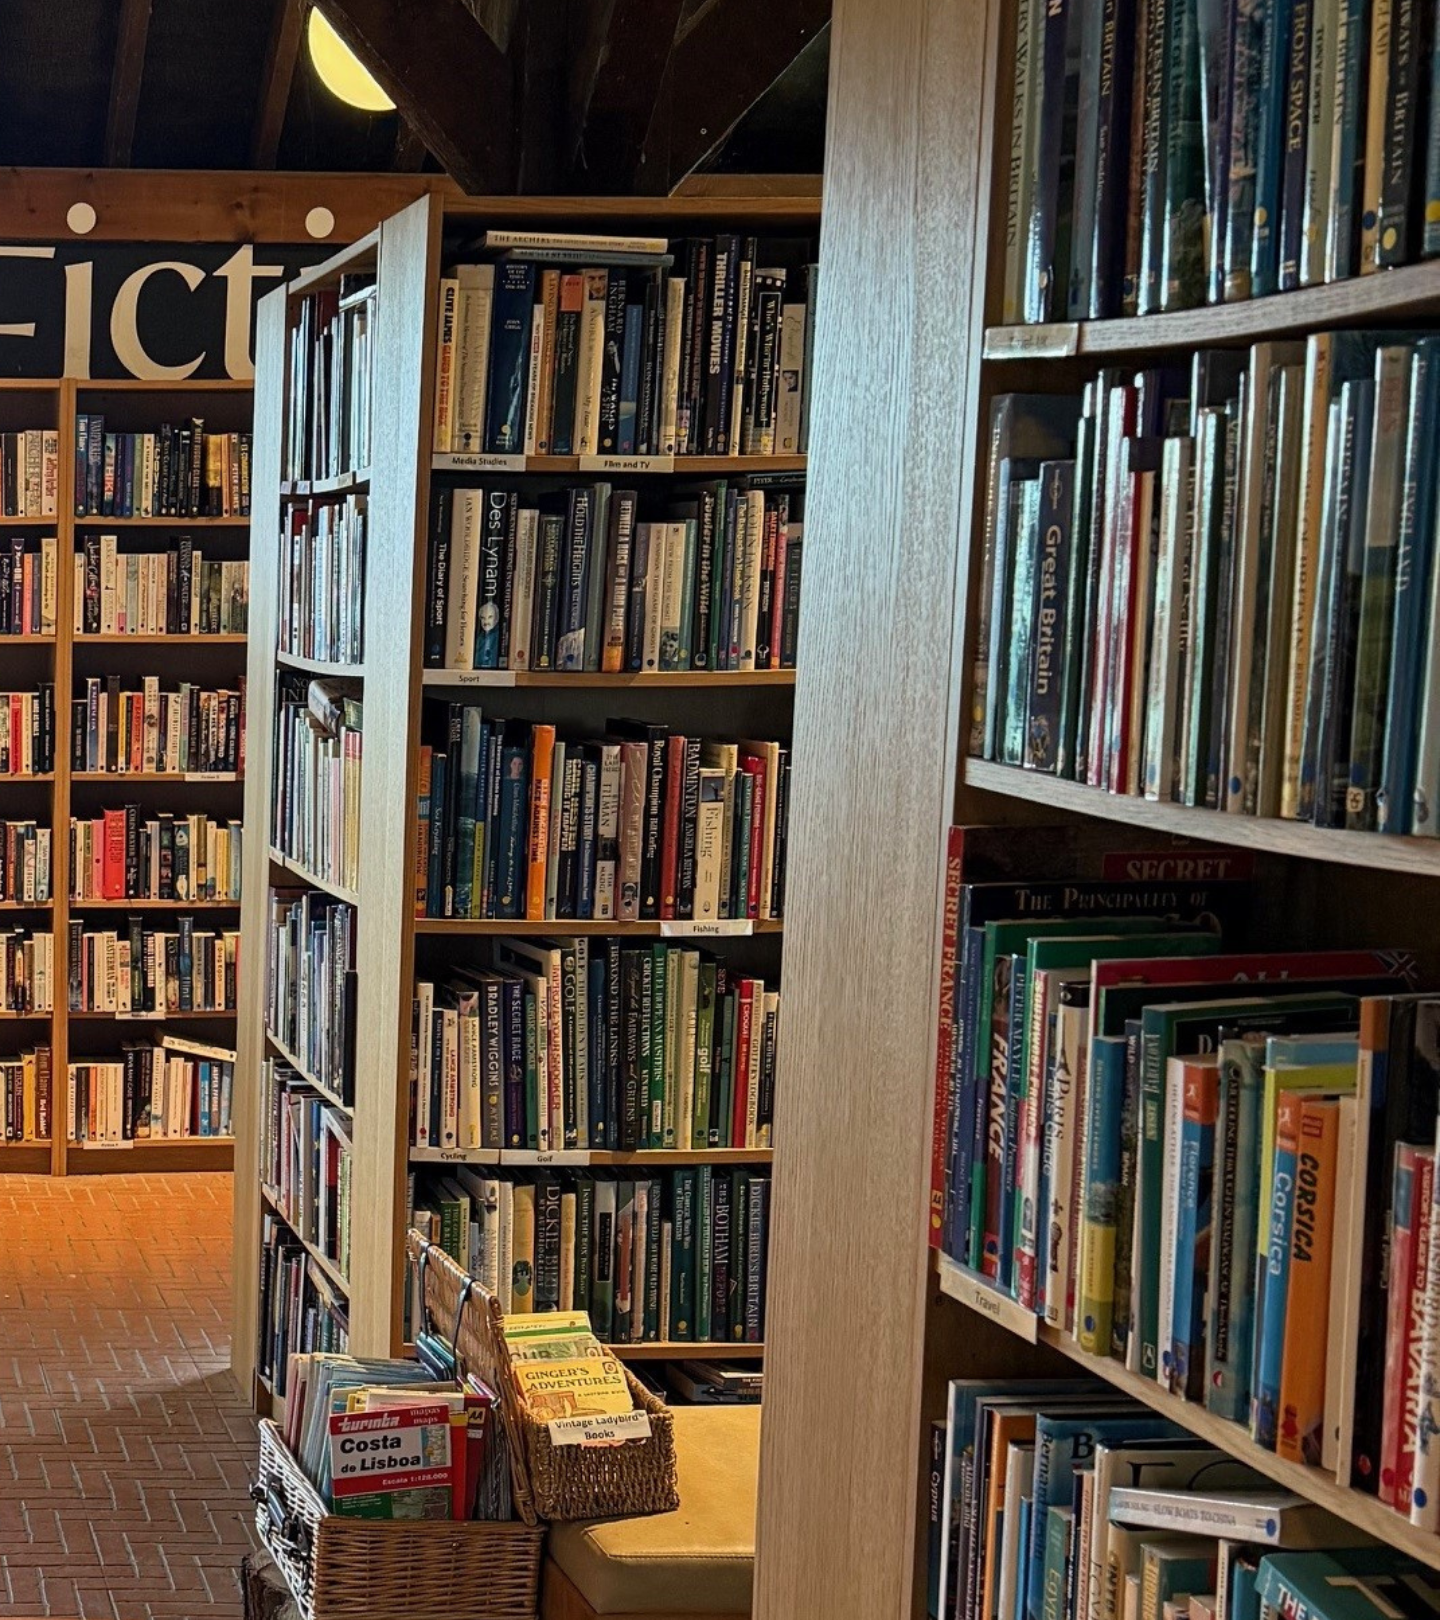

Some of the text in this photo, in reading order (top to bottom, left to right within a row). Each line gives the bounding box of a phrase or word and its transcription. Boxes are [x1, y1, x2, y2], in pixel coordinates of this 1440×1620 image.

[1101, 20, 1114, 95] BRITAIN
[1288, 2, 1307, 153] FROM SPACE
[1007, 40, 1028, 247] WALKS IN BRITAIN
[1390, 91, 1409, 185] BRITAIN
[443, 287, 455, 313] CLIVE
[608, 282, 617, 332] INGHAM
[615, 280, 625, 334] BERNARD
[709, 252, 728, 374] THRILLER MOVIES
[765, 301, 776, 330] Who's
[442, 314, 453, 343] JAMES
[763, 333, 774, 357] Who
[104, 466, 114, 500] HIKE
[452, 457, 507, 467] Media Studies
[575, 497, 588, 527] HOLD
[619, 500, 632, 534] BETWEEN
[482, 492, 506, 597] Des Lynam
[574, 528, 582, 545] THE
[617, 544, 629, 564] ROCK
[699, 496, 715, 614] Fowler in the Wild
[744, 505, 758, 609] COLIN JACKSON
[435, 543, 447, 625] The Diary of Sport
[571, 545, 585, 586] HEIGHTS
[612, 608, 624, 630] PLACE
[1036, 524, 1062, 694] Great Britain
[458, 675, 479, 684] Sport
[600, 782, 611, 827] TILMAN
[684, 743, 701, 818] BADMINTON
[127, 809, 136, 856] COLIN DEXTER
[531, 779, 542, 863] RACE AGAINST TIME
[683, 822, 695, 857] ANGELA
[701, 807, 719, 858] Fishing
[1126, 858, 1231, 880] SECRET
[942, 856, 961, 940] SECRET
[1016, 890, 1052, 911] THE
[1064, 888, 1178, 910] PRINCIPALITY
[693, 925, 719, 934] Fishing
[564, 974, 575, 1013] GOLF
[717, 968, 726, 994] SEVE
[939, 947, 957, 1029] FRANCE
[1012, 973, 1025, 1023] PETER
[511, 985, 522, 1061] THE SECRET RACE
[610, 946, 620, 1066] BEYOND THE LINKS
[641, 957, 652, 1056] CRICKET REFLECTIONS
[654, 957, 663, 1081] THE EUROPEAN MASTERS
[551, 964, 561, 1110] IMPROVE YOUR SNOOKER
[697, 1047, 711, 1073] golf
[1010, 1027, 1024, 1083] MAYLE
[1027, 979, 1045, 1138] SOUTHWEST FRANCE
[487, 985, 500, 1141] BRADLEY WIGGINS MY TIME
[988, 1032, 1008, 1165] FRANCE
[1055, 1077, 1071, 1140] PARIS
[441, 1152, 467, 1161] Cycling
[537, 1154, 553, 1163] Golf
[1186, 1140, 1199, 1208] Florence
[719, 1183, 727, 1203] THE
[1293, 1152, 1320, 1262] CORSICA
[545, 1186, 560, 1297] DICKIE BIRD
[714, 1204, 729, 1264] BOTHAM
[1268, 1172, 1292, 1275] Corsica
[748, 1186, 762, 1327] DICKIE BIRD'S BRITAIN
[975, 1291, 1000, 1316] Travel
[526, 1367, 589, 1380] GINGER'S
[530, 1375, 622, 1391] ADVENTURES
[1402, 1289, 1428, 1453] BAVARIA
[338, 1413, 400, 1432] turinta
[411, 1407, 441, 1417] mapas
[414, 1416, 438, 1425] maps
[469, 1411, 483, 1420] AA
[555, 1417, 593, 1430] Vintage
[585, 1429, 615, 1440] Books
[340, 1435, 402, 1454] Costa
[341, 1455, 421, 1474] de Lisboa
[1036, 1430, 1053, 1497] Bernard
[382, 1477, 408, 1486] Escala
[930, 1471, 941, 1522] Cyprus
